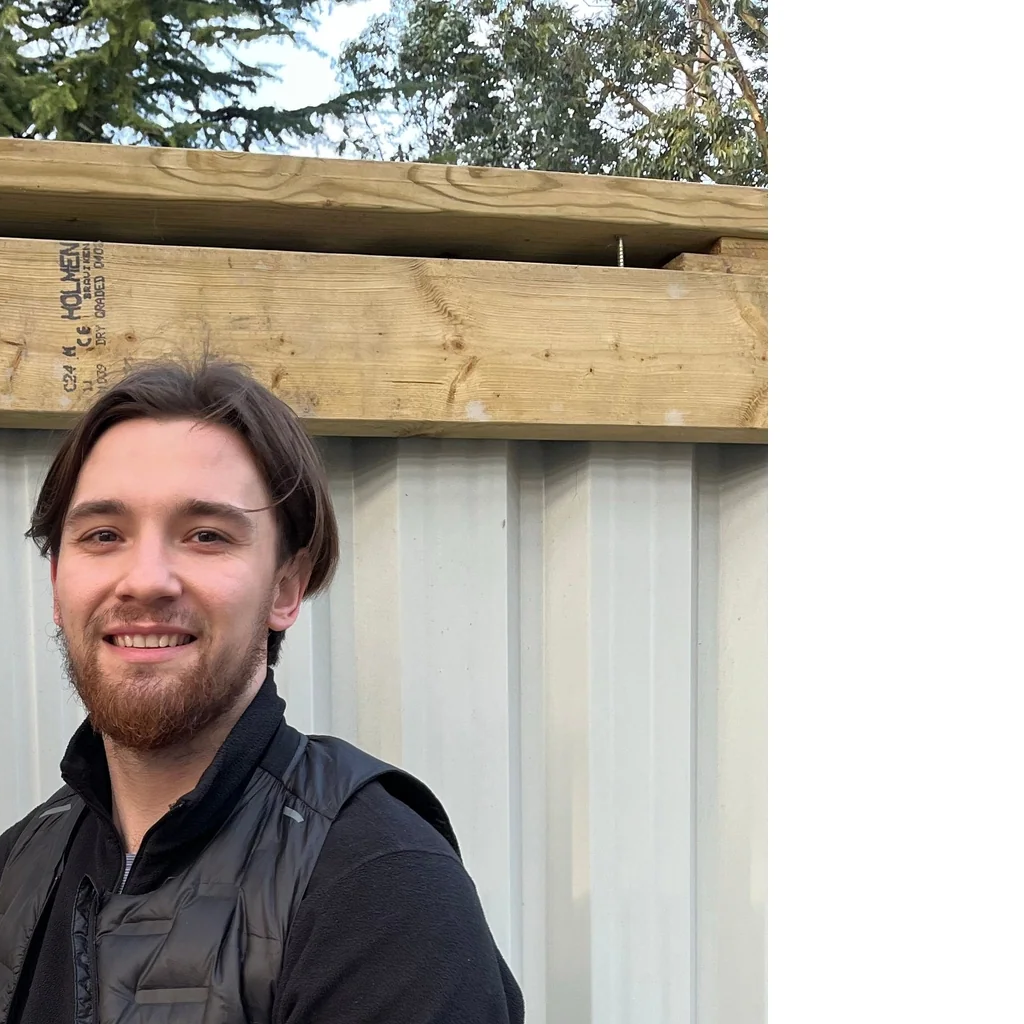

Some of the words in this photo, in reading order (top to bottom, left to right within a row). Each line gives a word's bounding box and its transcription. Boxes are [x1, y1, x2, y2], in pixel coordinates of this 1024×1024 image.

[59, 242, 82, 320] HOLMEN
[82, 243, 91, 299] BRAVIKEN
[93, 275, 105, 318] GRADED
[76, 326, 92, 347] CE
[95, 325, 106, 346] DRY
[63, 365, 77, 392] C24
